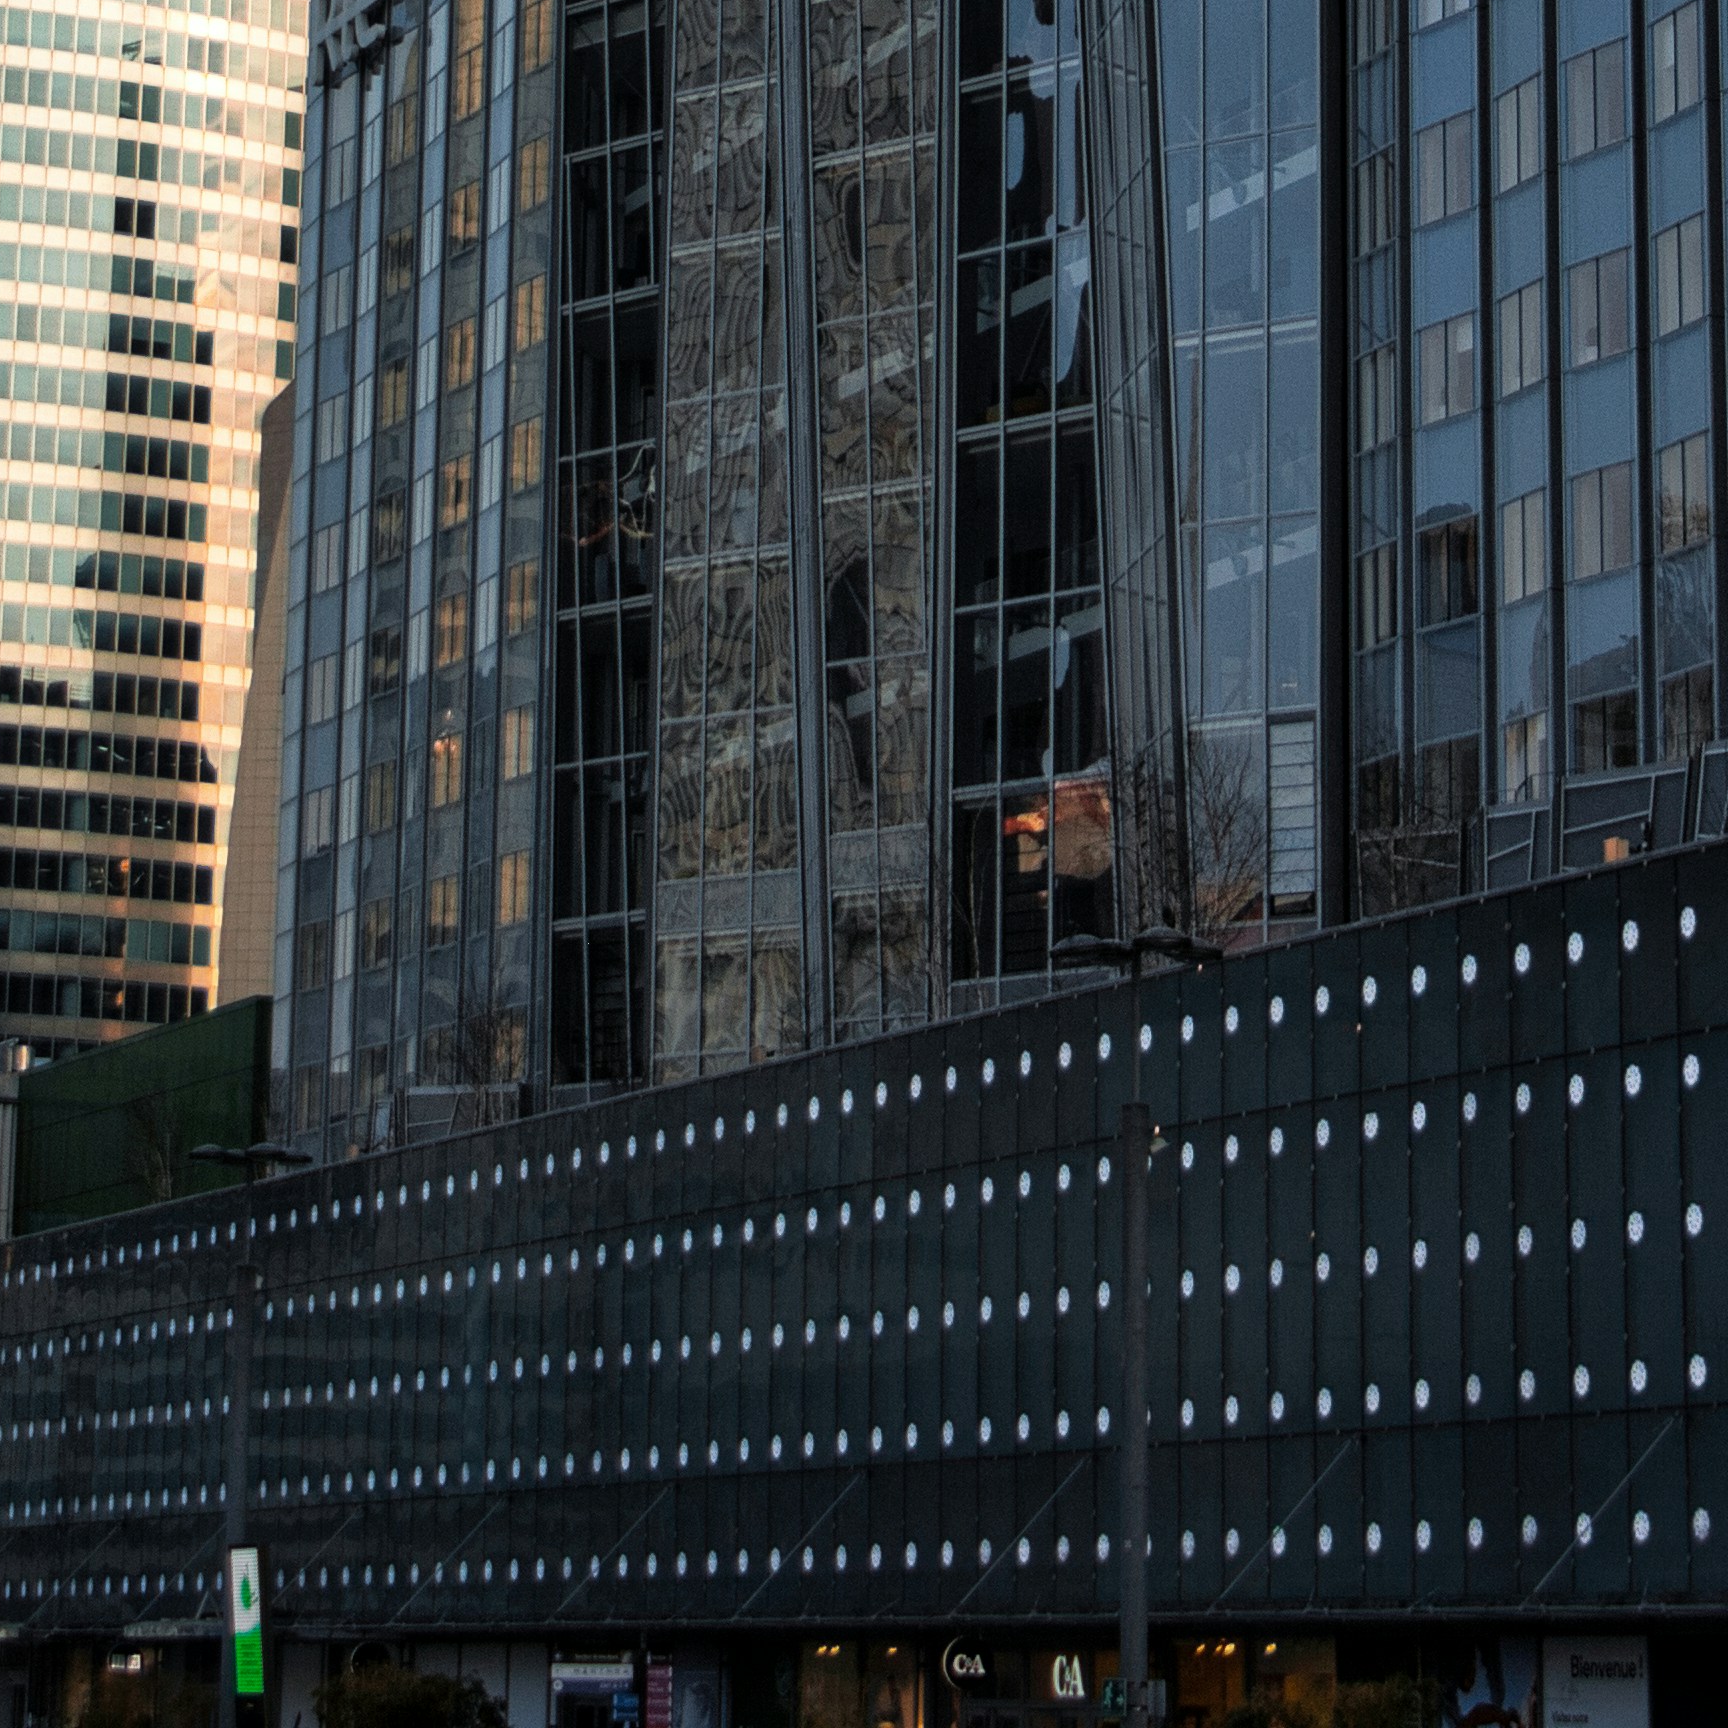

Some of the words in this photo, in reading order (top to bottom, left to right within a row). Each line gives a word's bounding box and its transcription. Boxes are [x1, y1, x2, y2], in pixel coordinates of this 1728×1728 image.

[953, 1654, 986, 1674] C&A
[1053, 1654, 1085, 1697] C&A
[1571, 1655, 1637, 1678] Bienvenue
